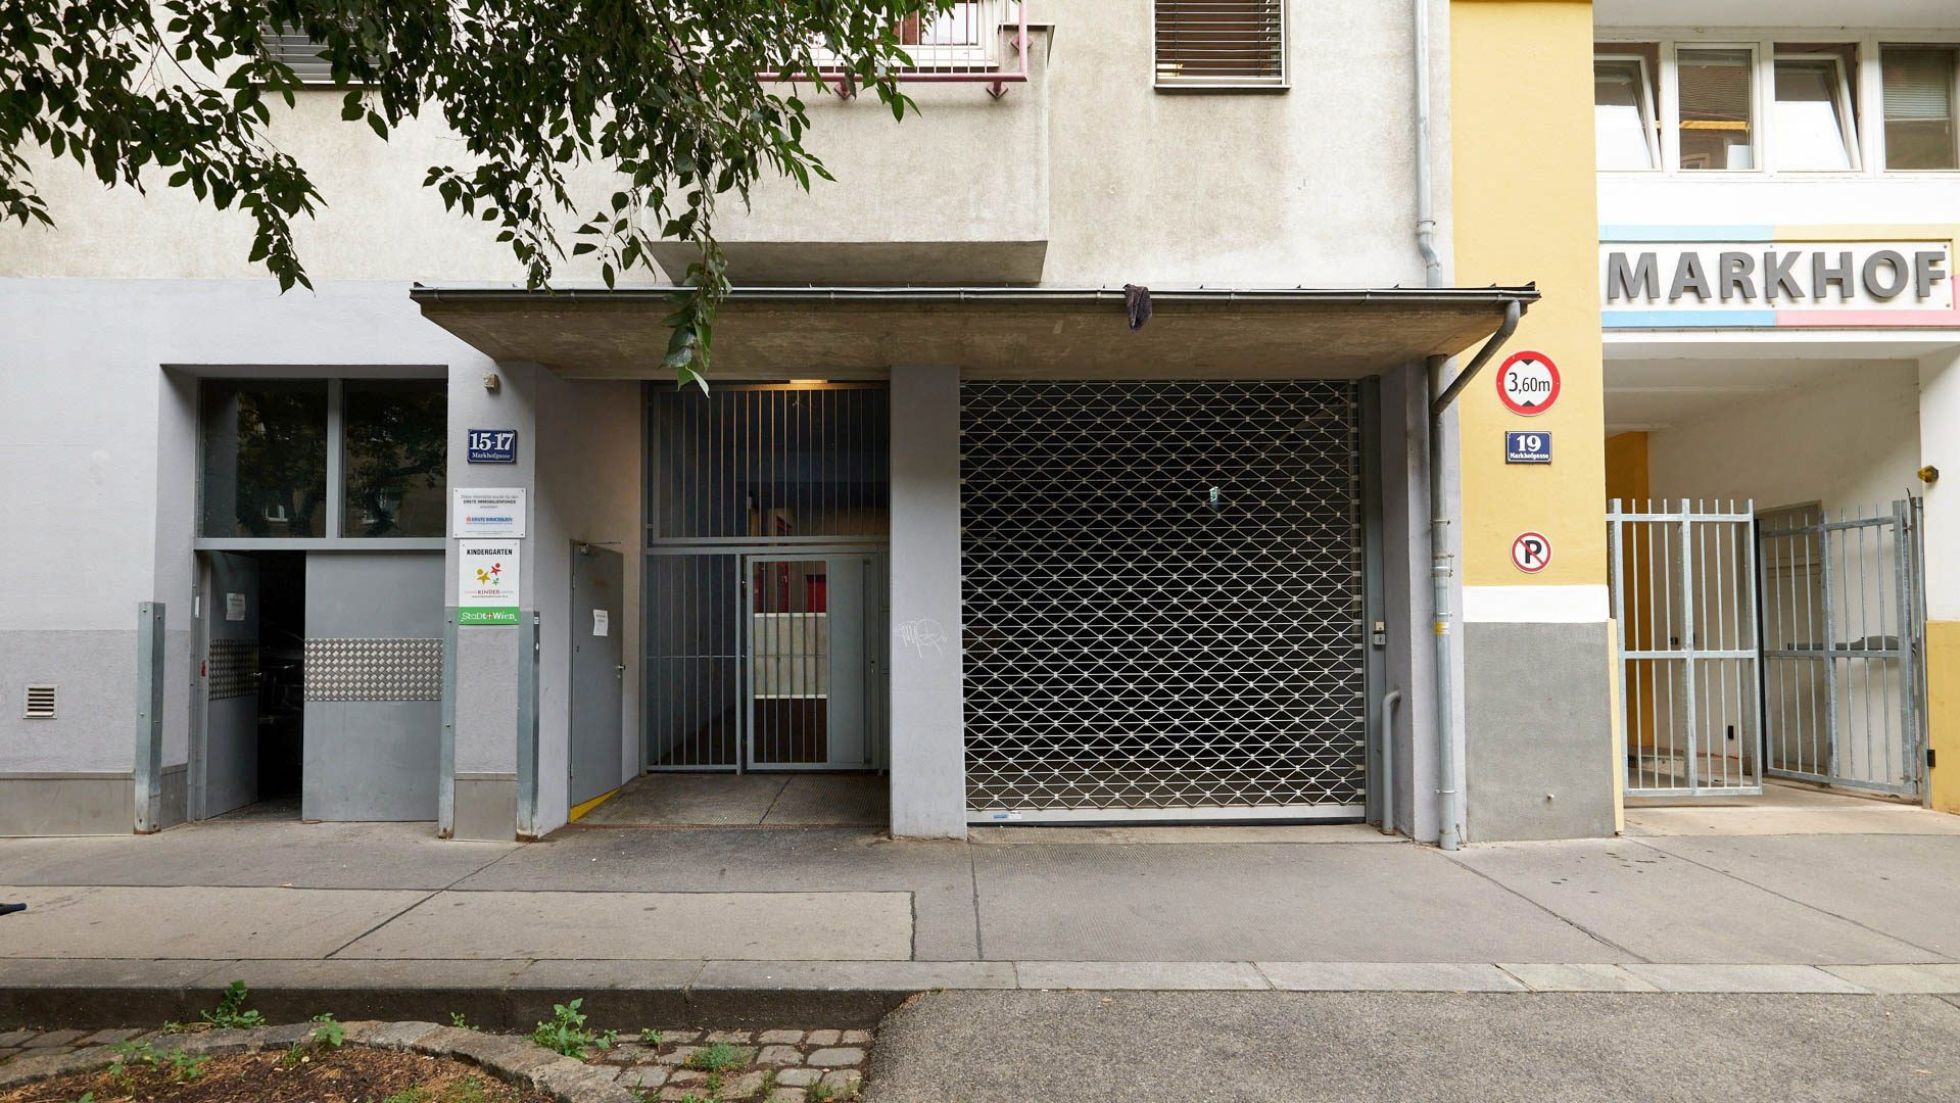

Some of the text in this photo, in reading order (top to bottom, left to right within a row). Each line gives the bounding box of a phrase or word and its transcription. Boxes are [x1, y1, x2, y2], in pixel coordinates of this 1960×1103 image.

[1607, 249, 1946, 300] MARKHOF
[1508, 372, 1551, 395] 3,60m
[470, 433, 514, 450] 15-17
[1516, 434, 1541, 452] 19
[1525, 539, 1542, 564] P
